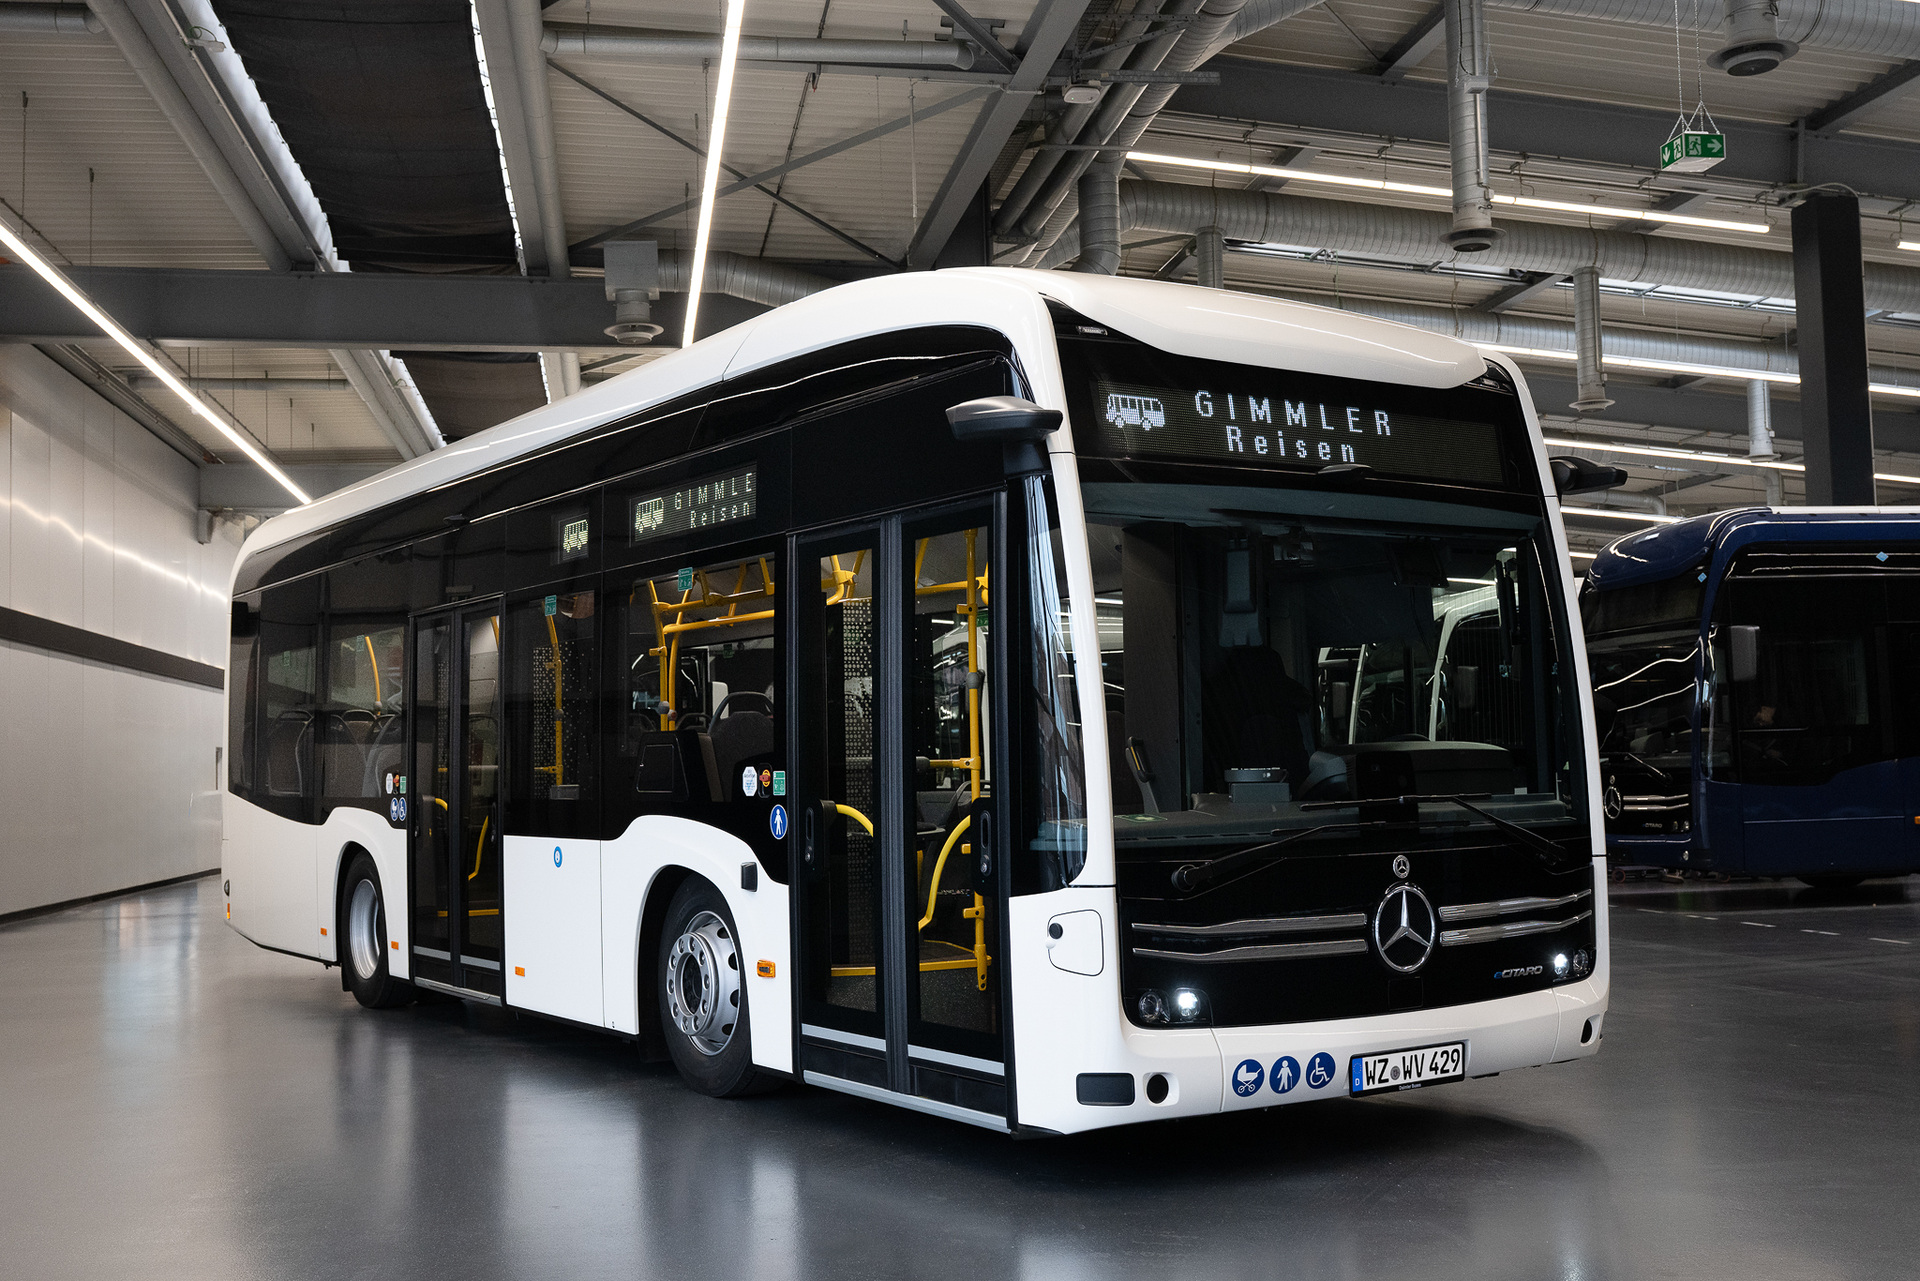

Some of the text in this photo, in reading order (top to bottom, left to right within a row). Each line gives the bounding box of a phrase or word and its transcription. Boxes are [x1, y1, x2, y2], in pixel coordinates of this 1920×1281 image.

[1194, 390, 1391, 436] GIMMLER
[1226, 425, 1355, 463] Reisen
[674, 472, 753, 510] GIMMLE
[691, 502, 750, 528] Reisen
[1494, 965, 1543, 979] eCITARO
[1365, 1058, 1389, 1086] WZ
[1402, 1053, 1425, 1080] WV
[1429, 1048, 1460, 1075] 429
